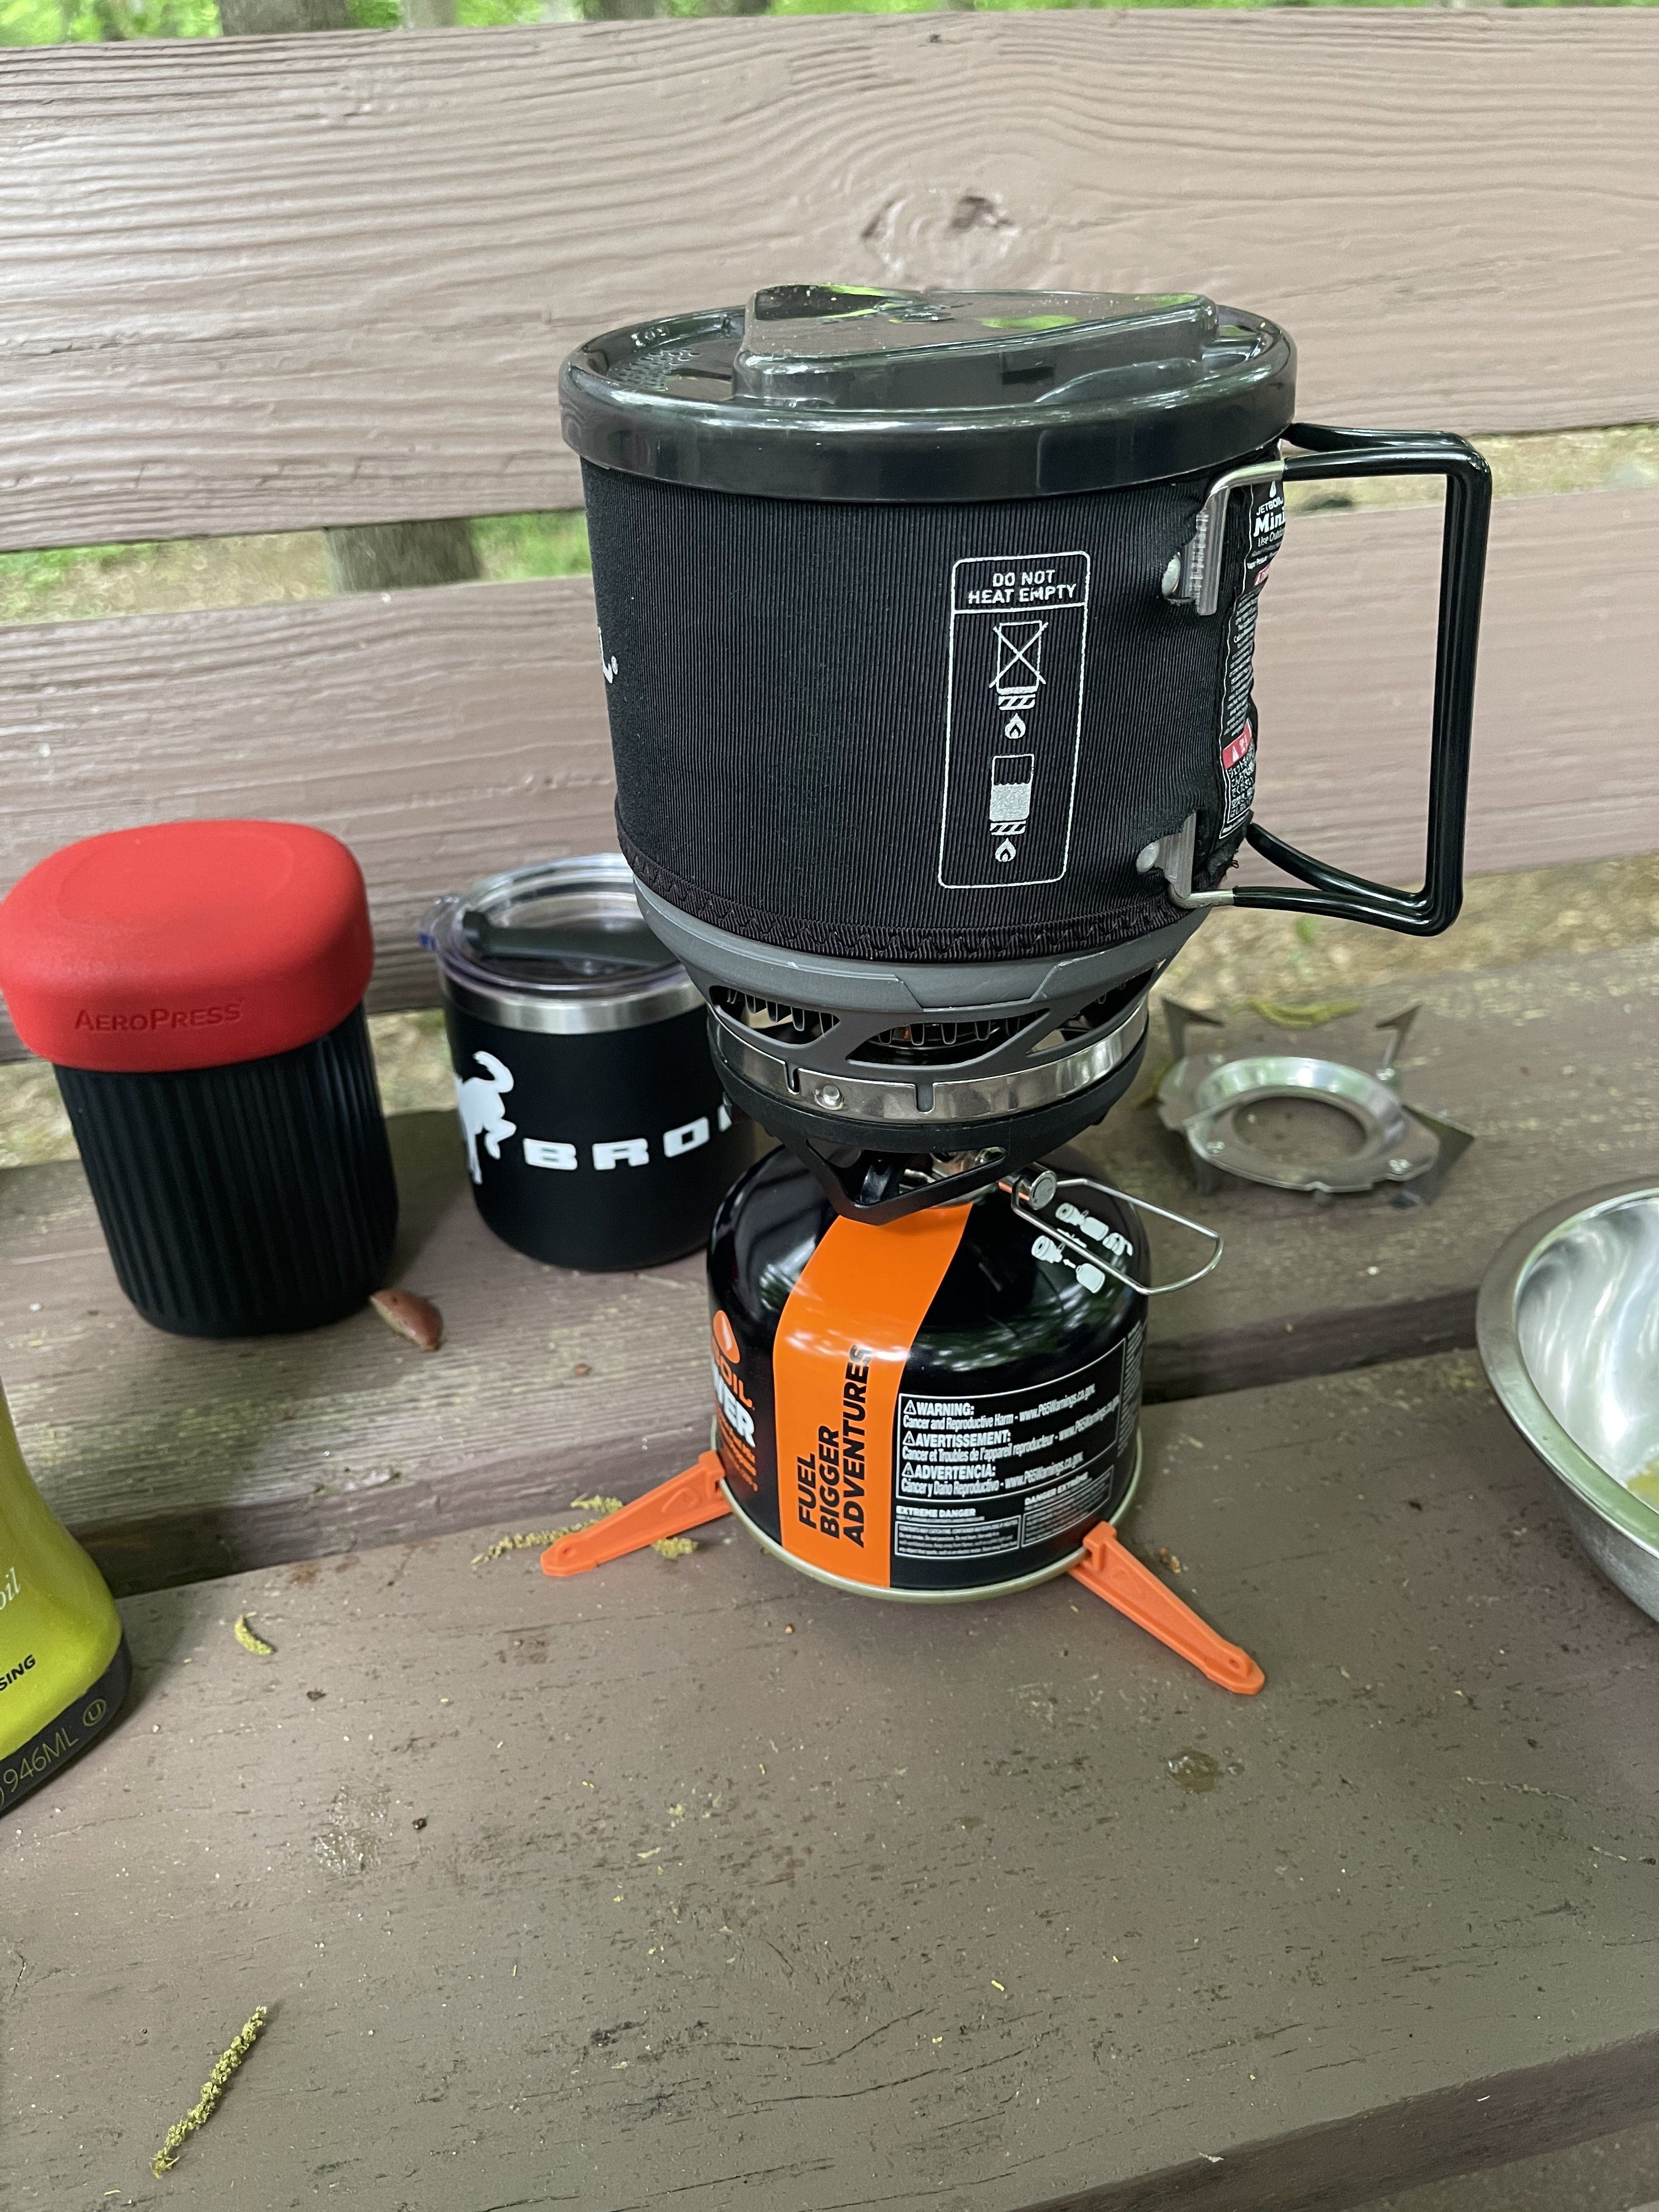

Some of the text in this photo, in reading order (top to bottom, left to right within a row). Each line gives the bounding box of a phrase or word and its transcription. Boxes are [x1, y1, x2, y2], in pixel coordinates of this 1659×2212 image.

[992, 569, 1056, 587] DO NOT
[968, 583, 1076, 604] HEAT EMPTY
[916, 1402, 975, 1416] WARNING:
[903, 1414, 930, 1429] Cancer
[930, 1417, 945, 1430] and
[946, 1414, 994, 1432] Reproductive
[995, 1413, 1014, 1426] Harm
[843, 1344, 873, 1548] ADVENTURES
[902, 1446, 929, 1462] Cancer
[929, 1448, 938, 1462] et
[938, 1448, 969, 1462] Troubles
[969, 1448, 979, 1462] de
[1013, 1434, 1054, 1457] reproducteur
[915, 1429, 1011, 1448] AVERTISSEMENT:
[914, 1463, 996, 1480] ADVERTENCIA:
[797, 1453, 817, 1530] FUEL
[819, 1425, 840, 1539] BIGGER
[927, 1482, 933, 1498] y
[953, 1478, 1000, 1498] Reproductivo
[896, 1505, 977, 1518] EXTREME DANGER
[3, 1727, 79, 1793] 946ML
